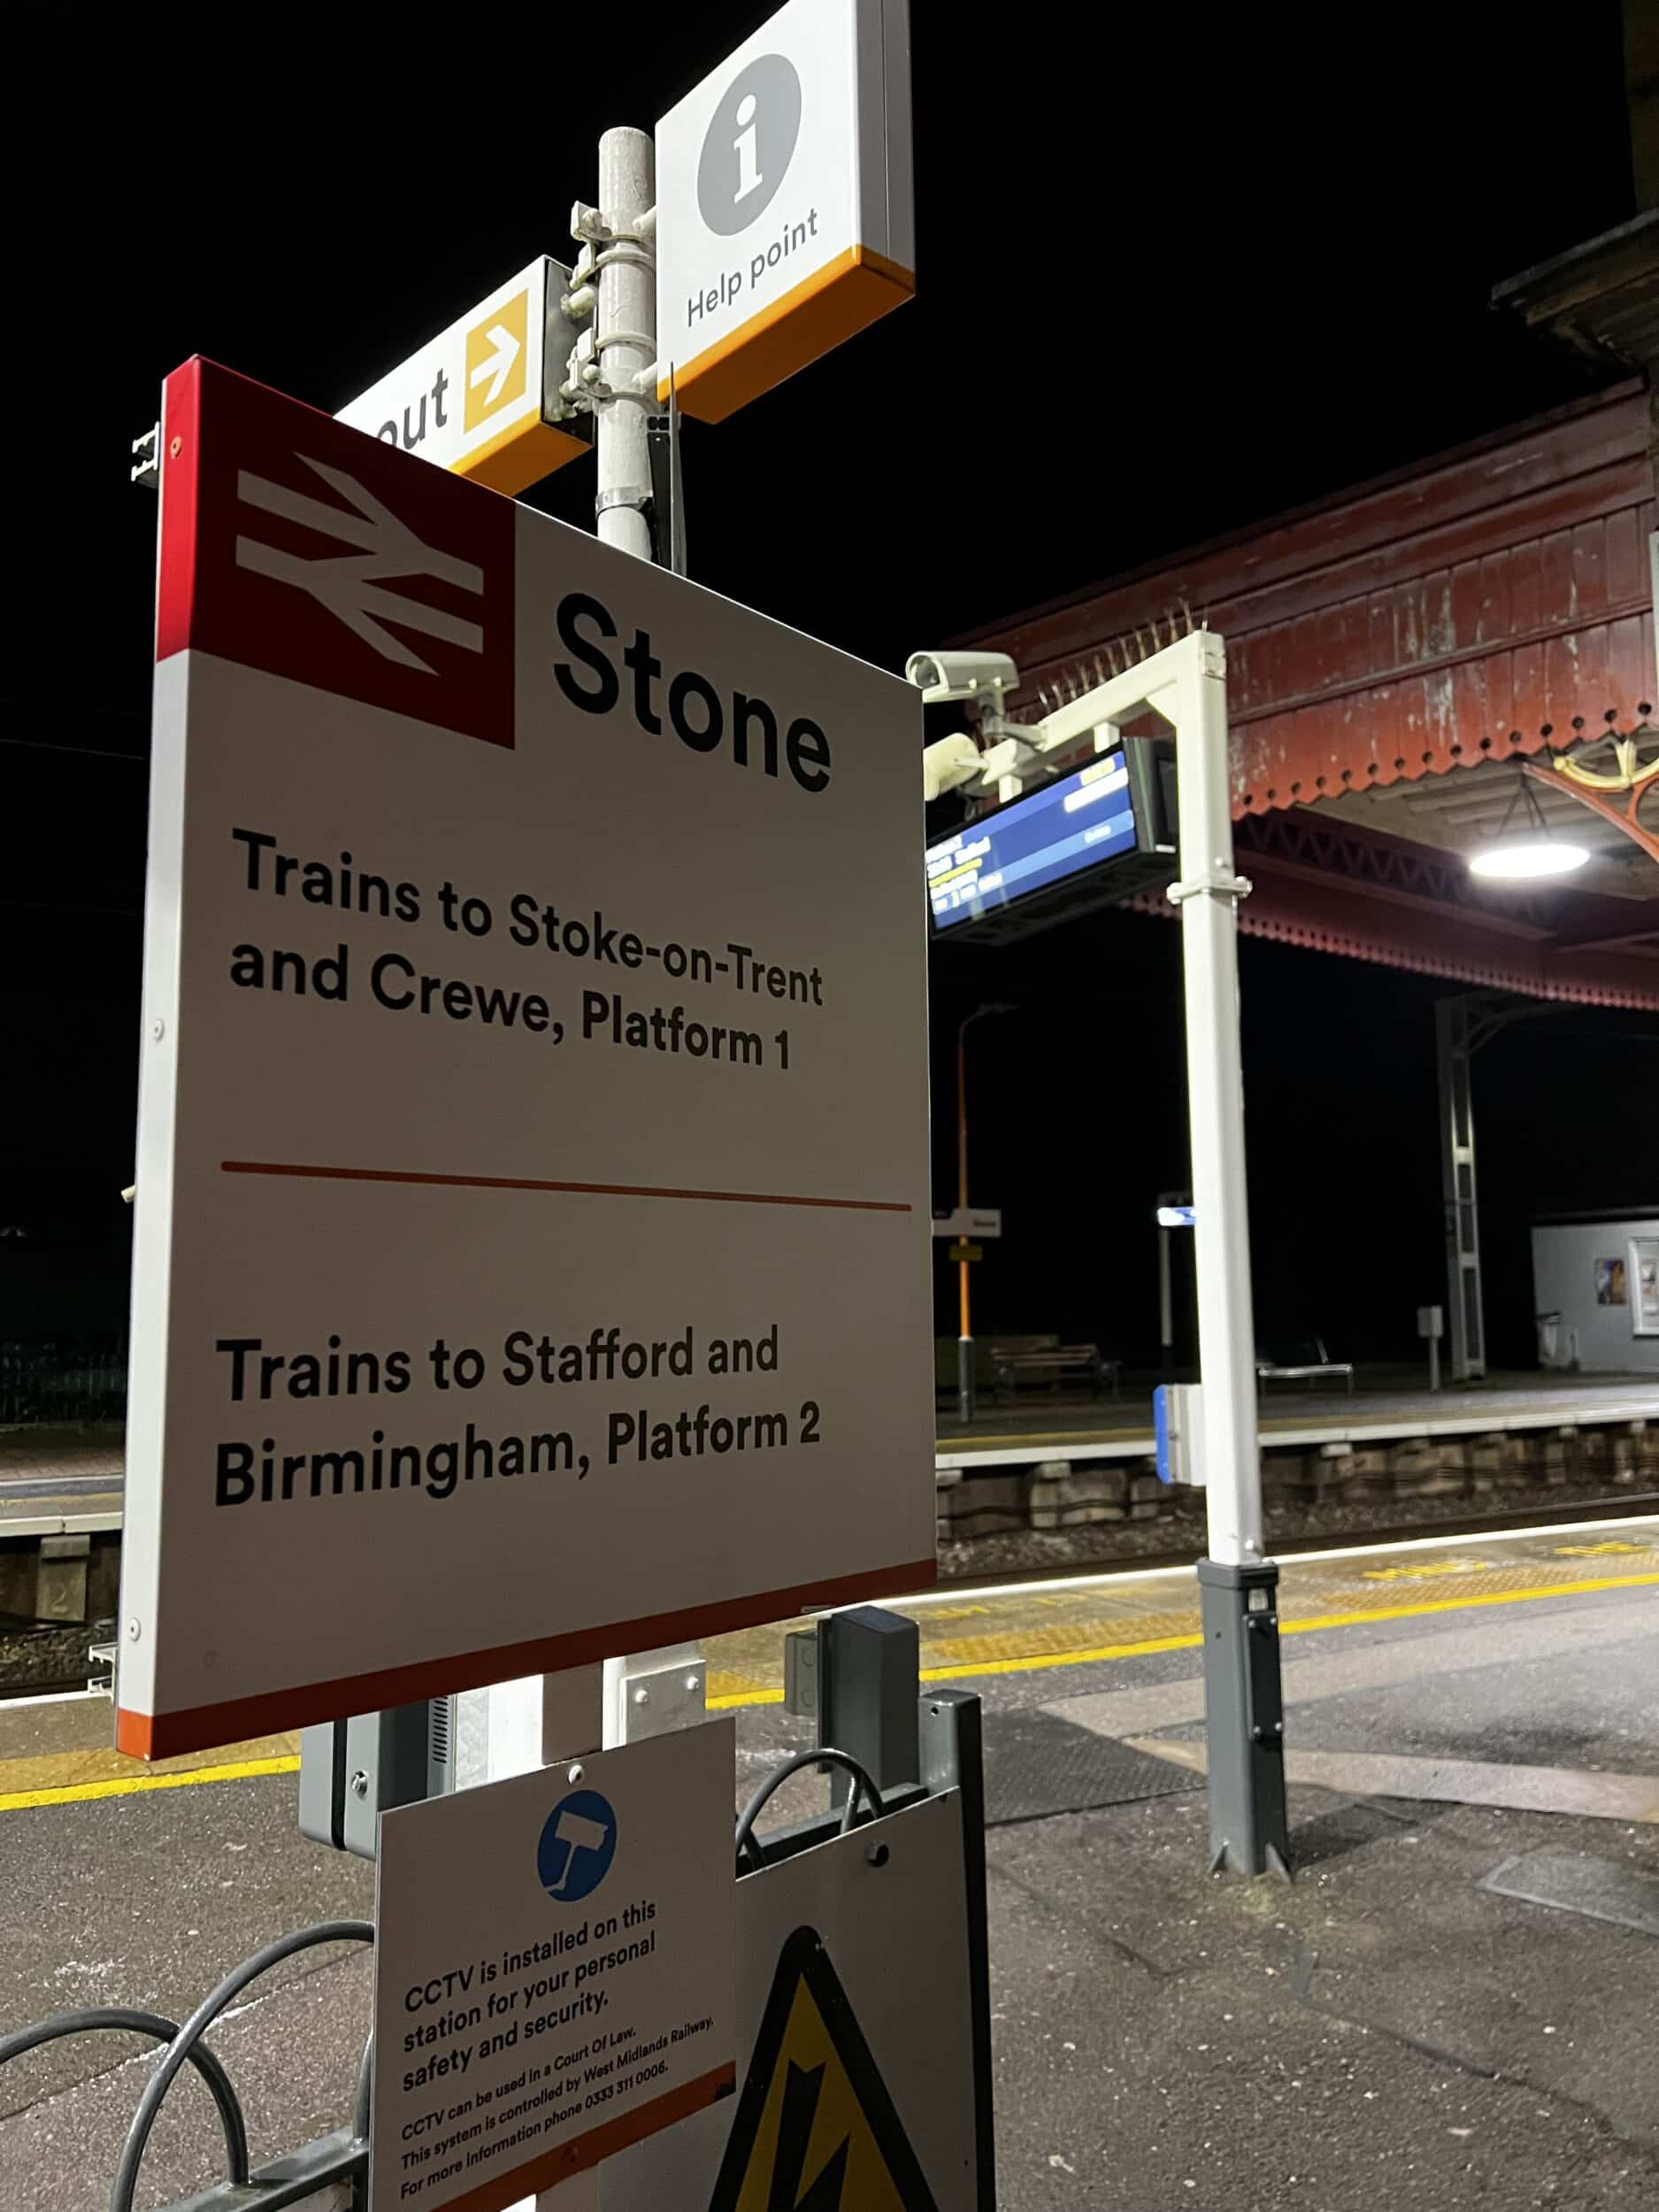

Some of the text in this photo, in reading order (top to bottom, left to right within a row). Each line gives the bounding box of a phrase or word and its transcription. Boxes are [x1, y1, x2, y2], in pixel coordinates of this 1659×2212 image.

[687, 207, 818, 327] Help point
[553, 593, 832, 794] Stone
[231, 827, 823, 1006] Trains to Stoke-on-Trent
[229, 942, 788, 1070] and Crewe, Platform 1
[215, 1324, 778, 1402] Trains to Stafford and
[215, 1401, 820, 1508] Birmingham, Platform 2
[403, 1930, 656, 2053] station for your personal
[404, 1900, 656, 2013] CCTV is installed on this
[402, 2027, 636, 2140] CCTV can be used in a Court Of Law.
[402, 2016, 714, 2170] This system is controlled by West Midlands Railway.
[403, 1988, 609, 2092] safety and security.
[401, 2179, 425, 2200] For
[426, 2161, 463, 2187] more
[465, 2124, 541, 2168] information
[544, 2102, 582, 2133] phone
[585, 2085, 614, 2109] 0333
[616, 2075, 634, 2094] 311
